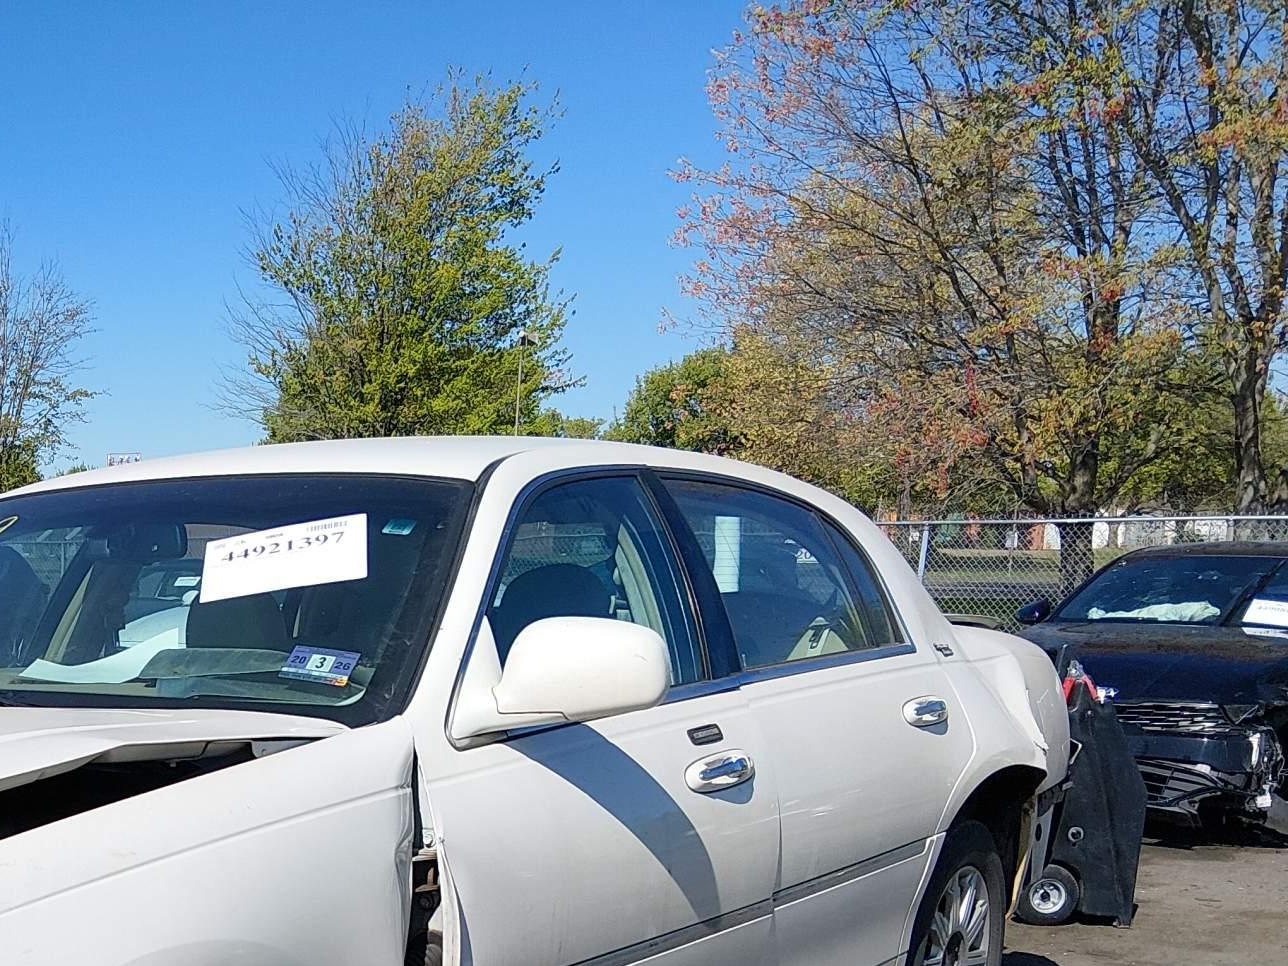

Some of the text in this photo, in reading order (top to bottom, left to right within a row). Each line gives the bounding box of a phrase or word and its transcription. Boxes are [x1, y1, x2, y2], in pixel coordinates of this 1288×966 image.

[220, 531, 345, 562] 44921397
[290, 654, 352, 671] 20 3 26
